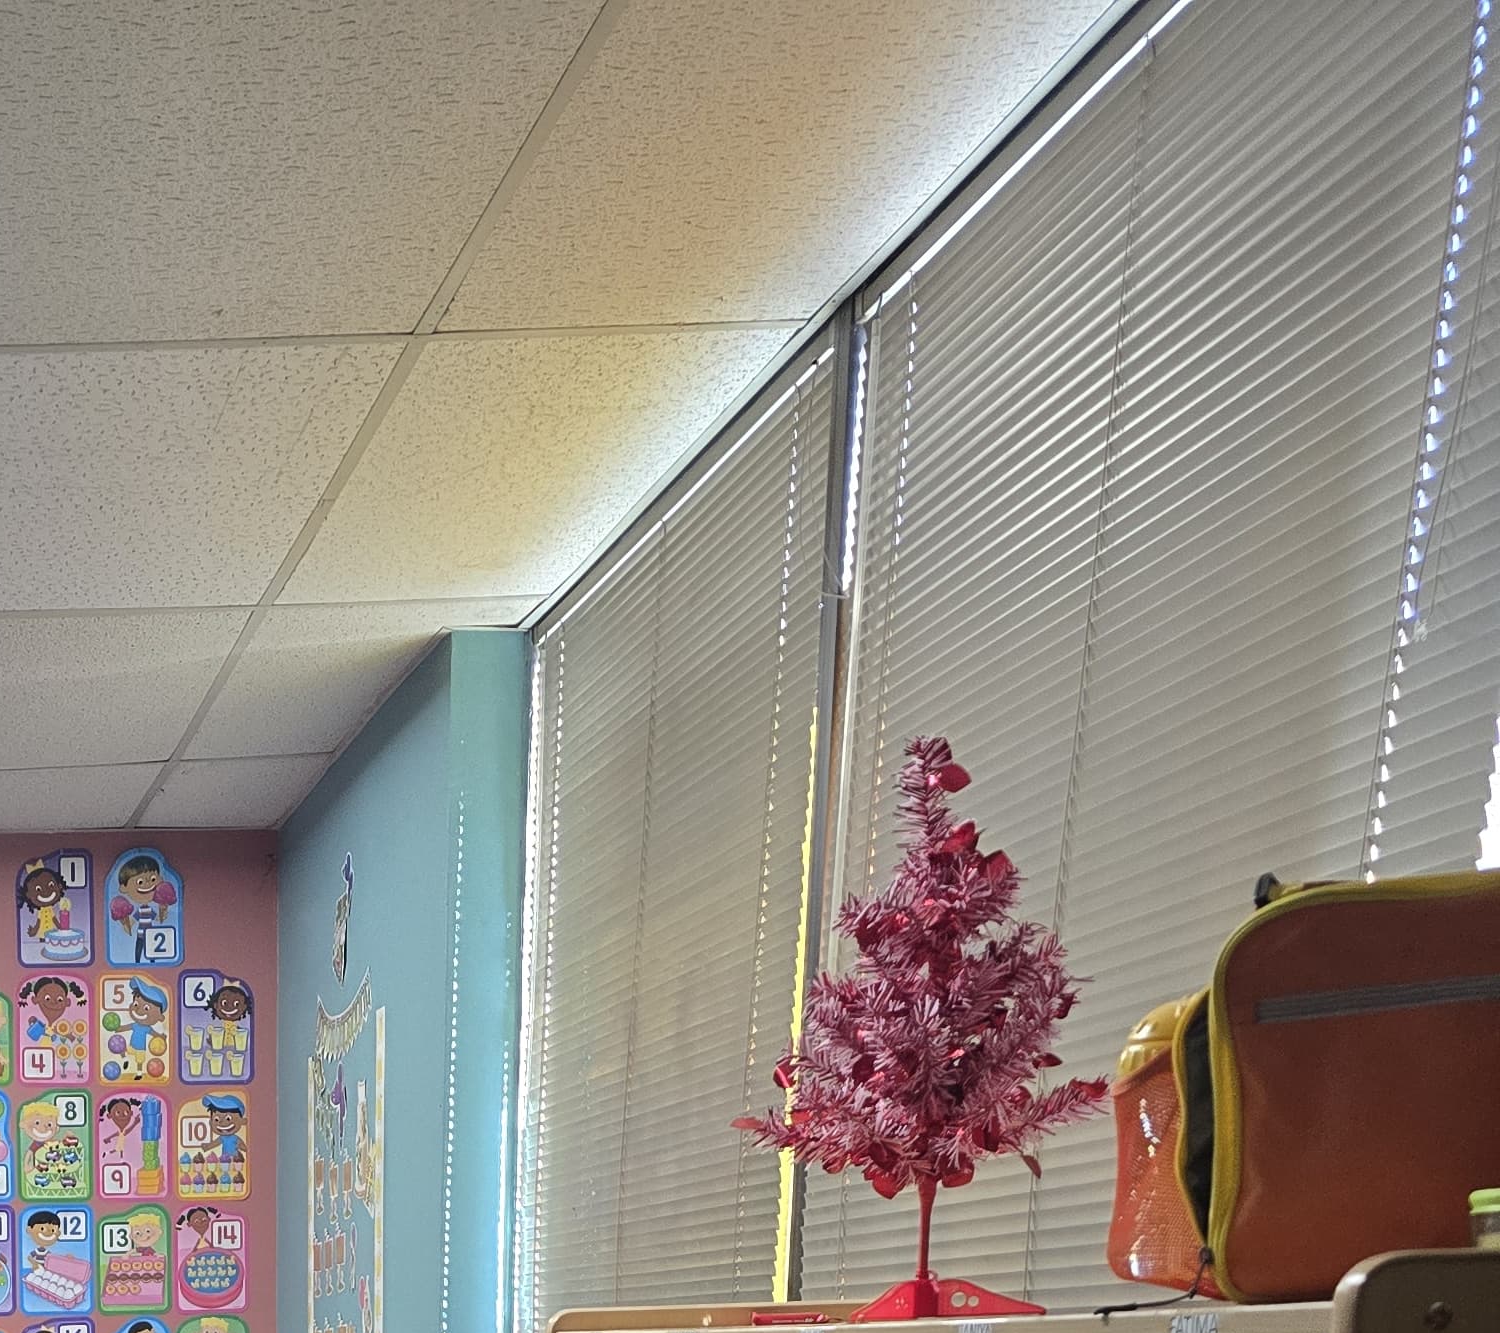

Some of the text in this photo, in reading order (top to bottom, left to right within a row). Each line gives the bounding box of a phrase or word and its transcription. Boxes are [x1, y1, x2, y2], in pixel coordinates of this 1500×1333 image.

[154, 933, 167, 953] 2
[113, 985, 125, 1004] 5
[194, 982, 205, 1001] 6
[32, 1054, 45, 1072] 4
[64, 1102, 76, 1120] 8
[189, 1123, 210, 1141] 10
[111, 1170, 124, 1189] 9
[64, 1217, 81, 1234] 12
[109, 1229, 128, 1247] 13
[218, 1226, 237, 1244] 14
